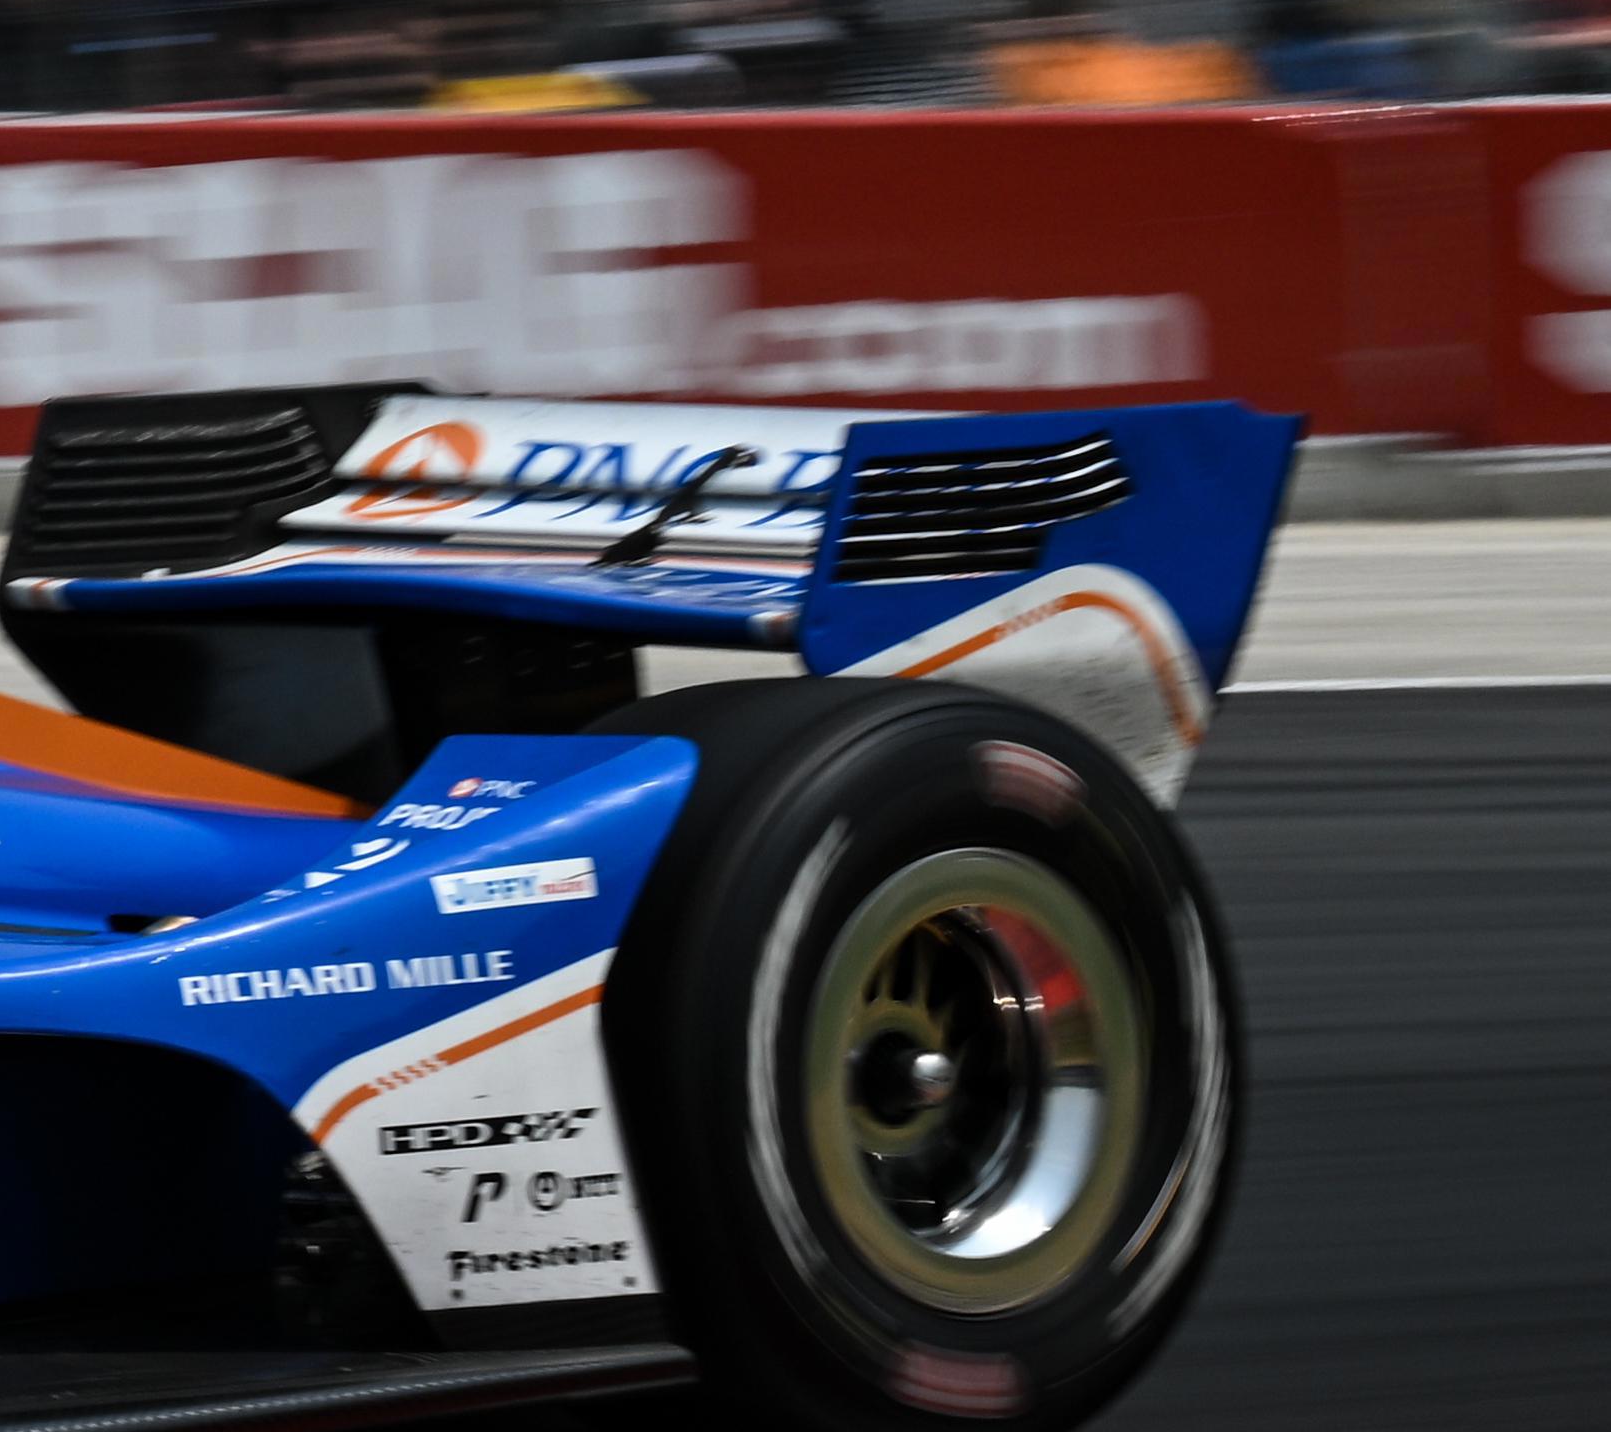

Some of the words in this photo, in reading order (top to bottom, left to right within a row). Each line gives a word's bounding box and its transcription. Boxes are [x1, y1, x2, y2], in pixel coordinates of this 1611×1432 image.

[178, 961, 377, 1006] RICHARD
[385, 950, 517, 990] MILLE
[381, 1122, 494, 1152] HPD
[445, 1240, 631, 1282] Firestone
